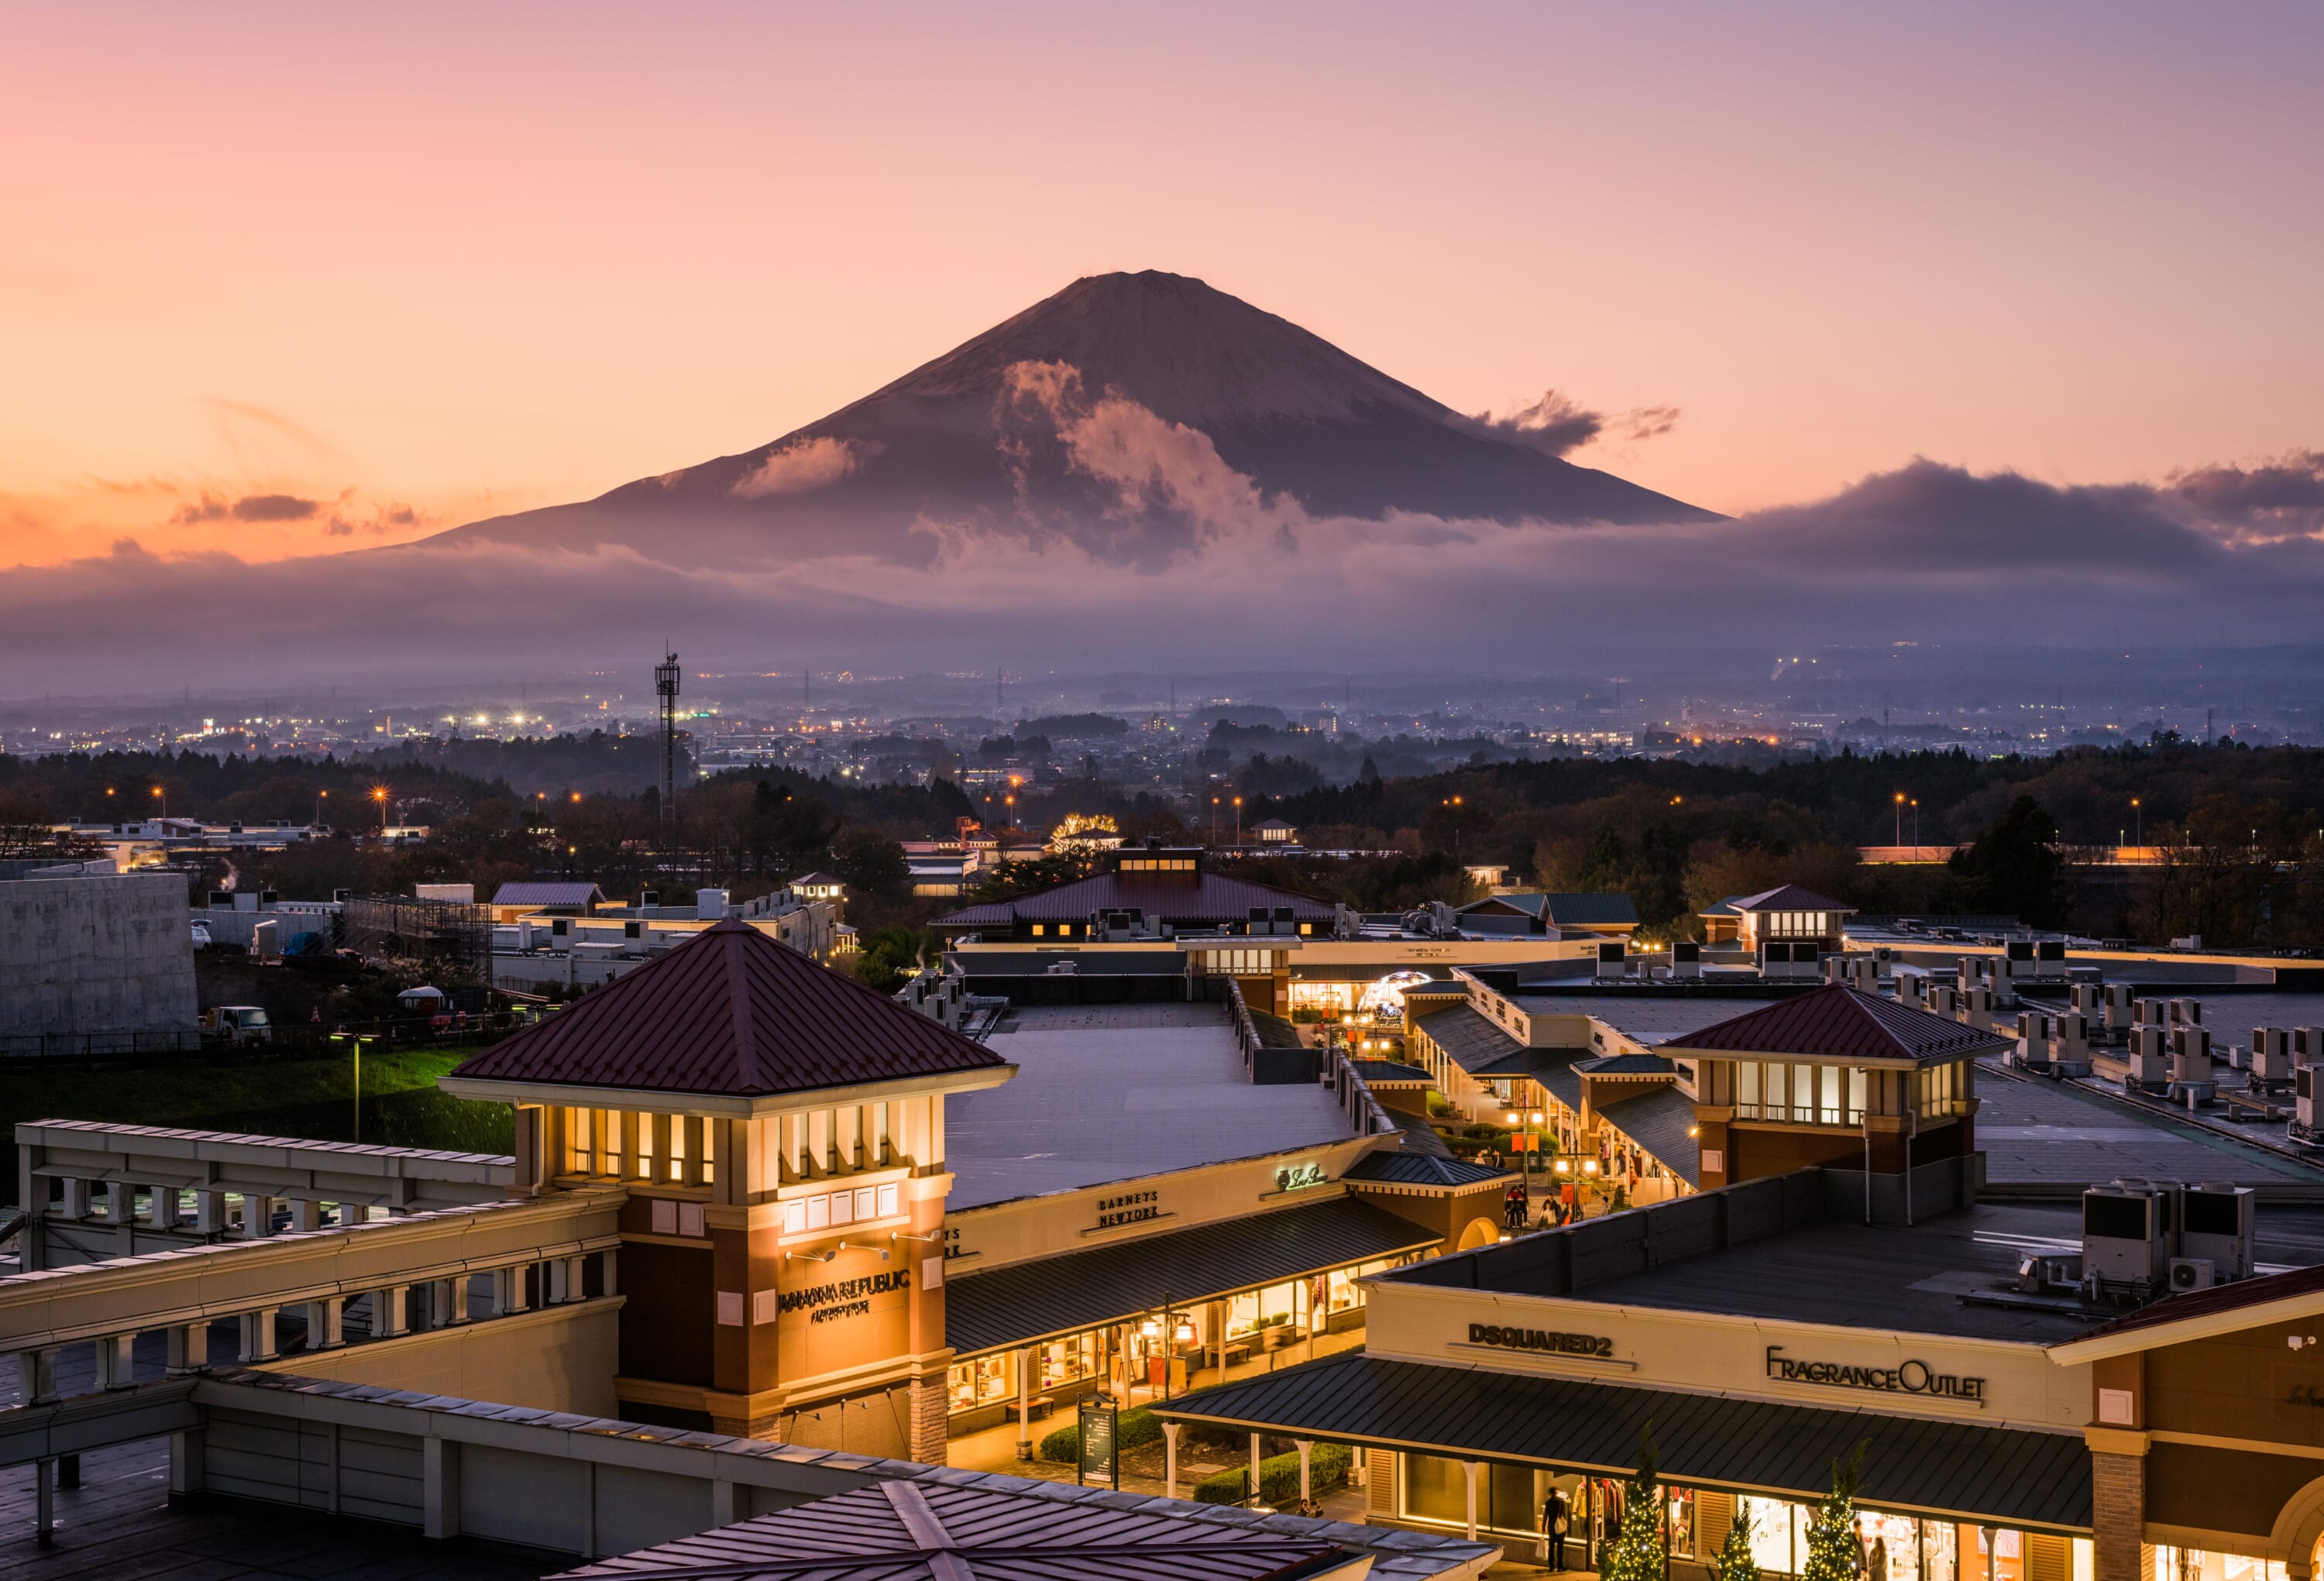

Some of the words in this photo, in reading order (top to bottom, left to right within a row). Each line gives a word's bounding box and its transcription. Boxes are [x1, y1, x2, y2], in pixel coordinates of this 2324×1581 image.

[1098, 1191, 1158, 1211] BARNEYS
[778, 1283, 839, 1314] BANANA
[839, 1269, 911, 1301] REPUBLIC
[1468, 1323, 1612, 1357] DSQUARED2
